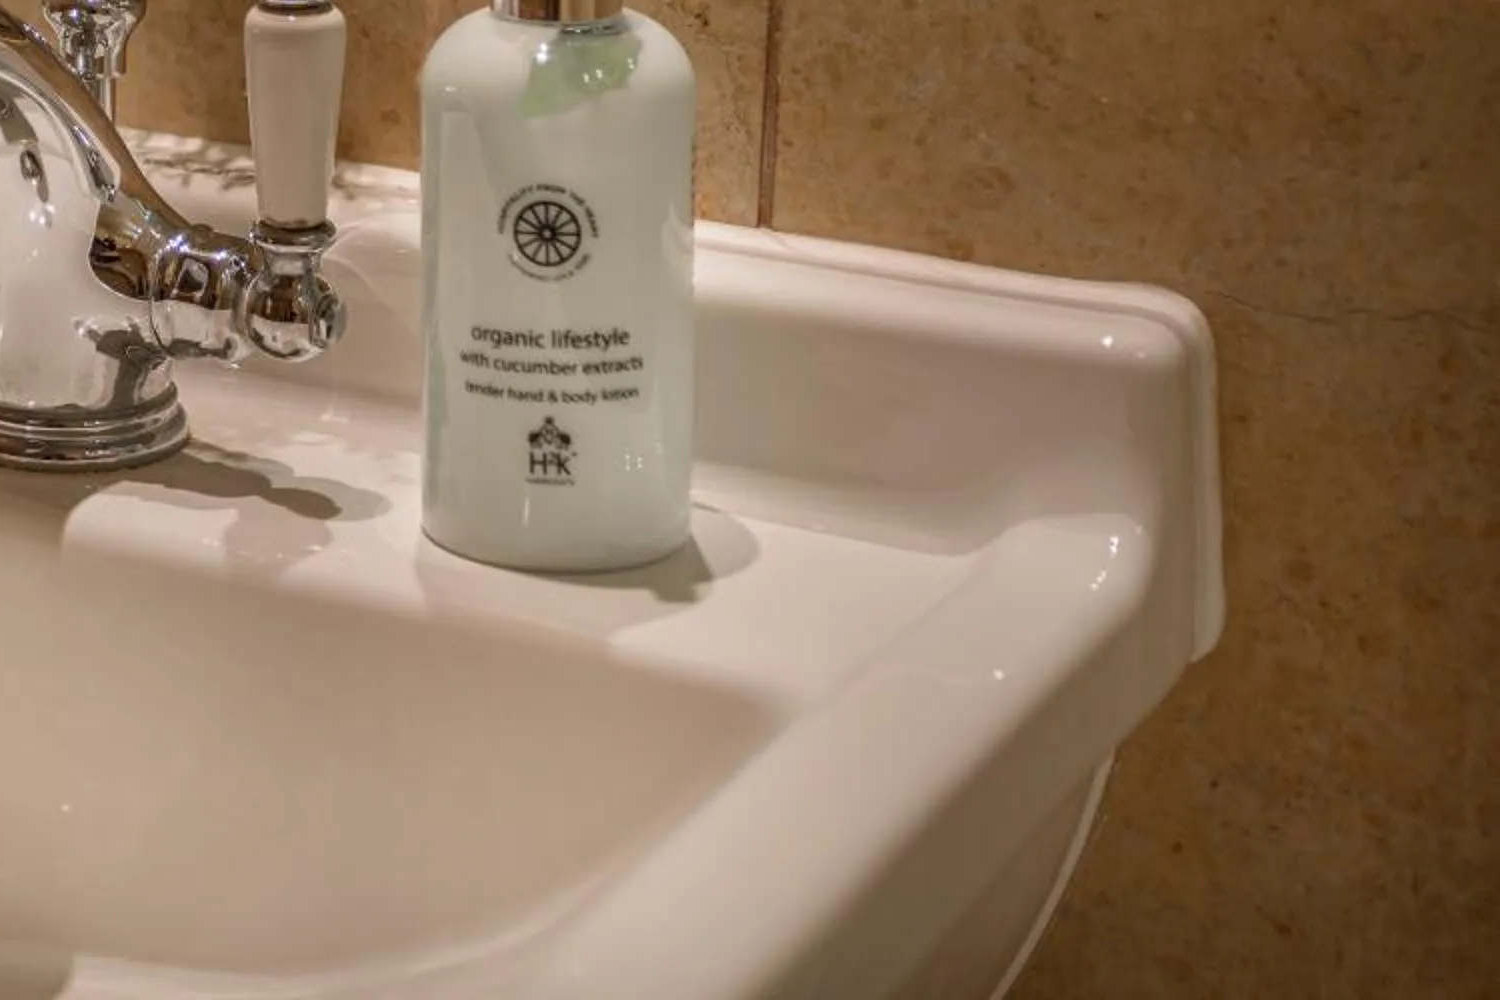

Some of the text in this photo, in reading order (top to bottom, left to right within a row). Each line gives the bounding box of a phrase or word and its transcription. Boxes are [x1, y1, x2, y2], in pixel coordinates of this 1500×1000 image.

[471, 326, 630, 352] organic lifestyle
[460, 350, 490, 370] with
[493, 358, 578, 376] cucumber
[506, 387, 544, 403] hand
[561, 388, 598, 406] body
[601, 387, 640, 401] lotion
